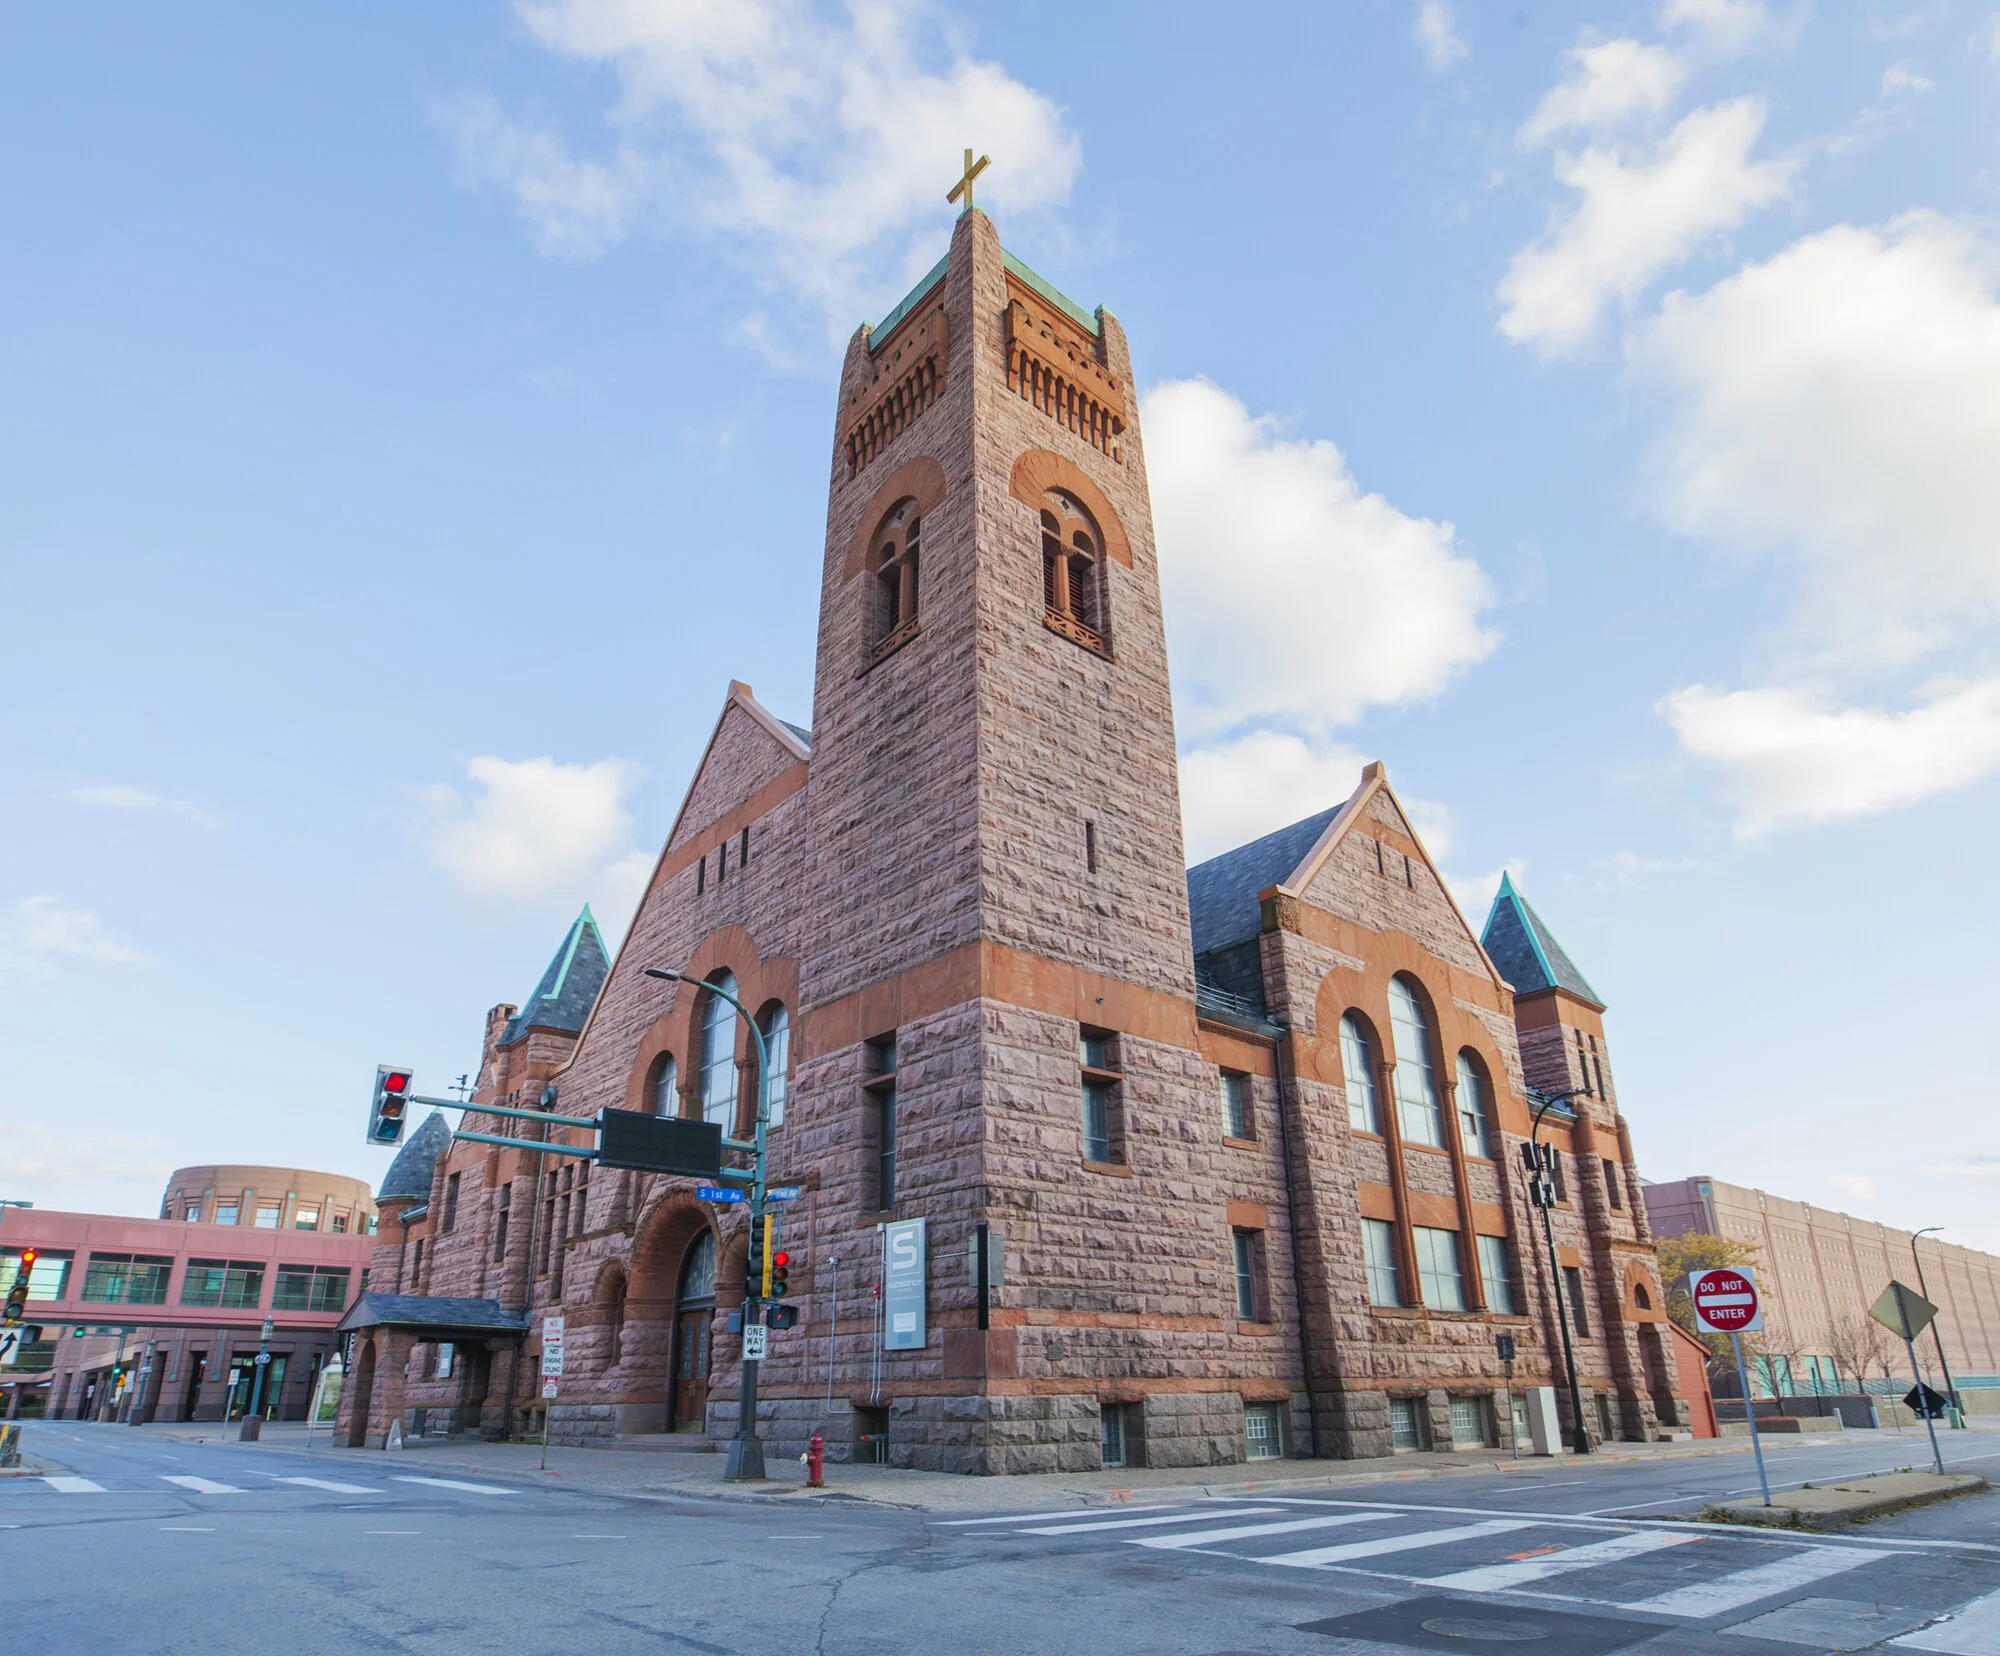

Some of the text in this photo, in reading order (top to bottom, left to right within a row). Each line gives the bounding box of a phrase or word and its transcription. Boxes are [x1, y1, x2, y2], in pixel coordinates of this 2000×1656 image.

[700, 1189, 741, 1200] S 1st Av
[892, 1231, 918, 1270] S
[1700, 1280, 1742, 1292] DO NOT
[1709, 1308, 1746, 1320] ENTER
[747, 1327, 764, 1336] ONE
[747, 1337, 764, 1346] WAY
